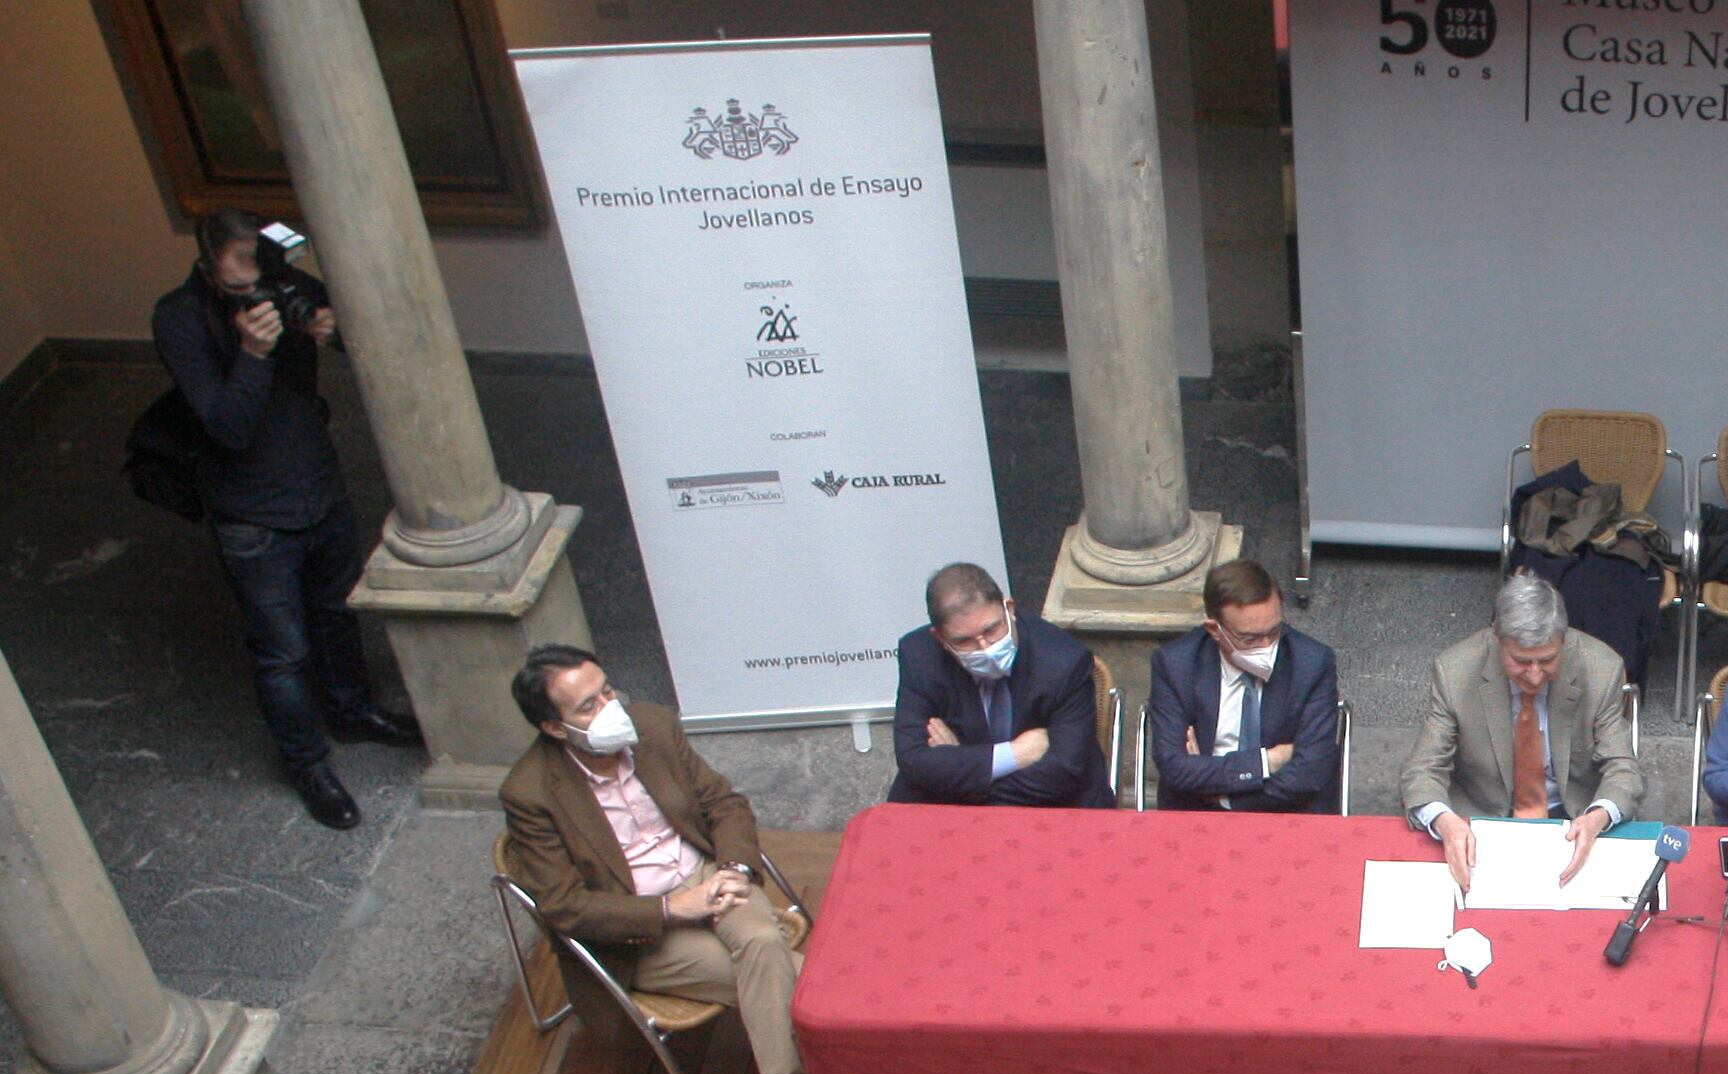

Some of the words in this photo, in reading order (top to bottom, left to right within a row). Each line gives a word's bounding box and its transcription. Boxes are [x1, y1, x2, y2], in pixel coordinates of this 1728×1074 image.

[1445, 8, 1487, 23] 1971
[1445, 24, 1487, 39] 2021
[1562, 23, 1668, 66] Casa
[1560, 75, 1611, 115] de
[576, 186, 655, 207] Premio
[658, 177, 804, 205] Internacional
[810, 177, 836, 197] de
[842, 174, 923, 198] Ensayo
[699, 207, 814, 231] Jovellanos
[744, 280, 793, 290] ORGANIZA
[746, 357, 824, 378] NOBEL
[770, 430, 827, 441] COLABORAN
[851, 476, 889, 488] CAJA
[892, 473, 946, 486] RURAL
[1662, 833, 1682, 851] tve
